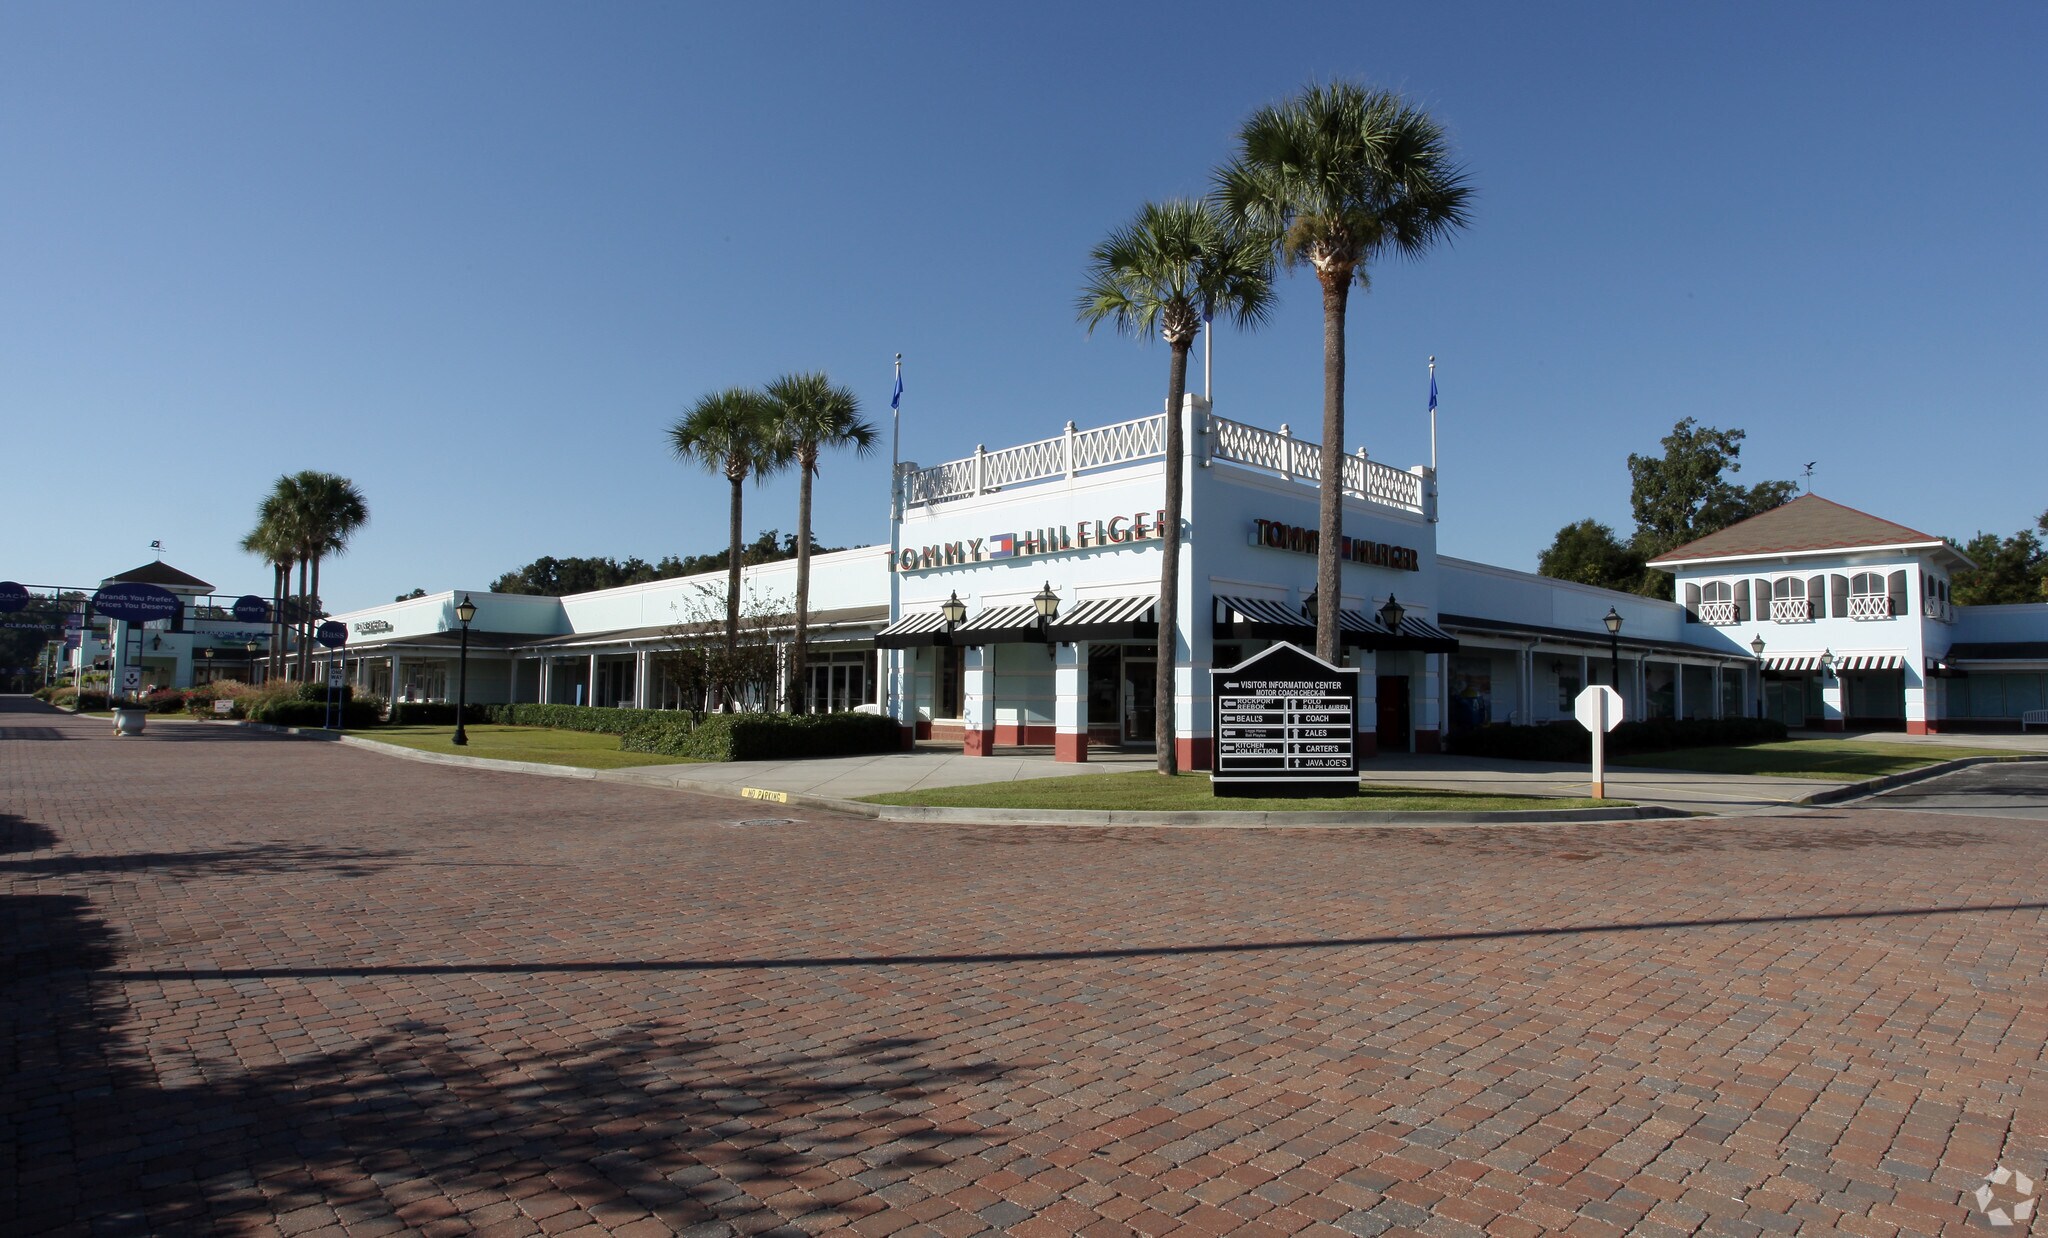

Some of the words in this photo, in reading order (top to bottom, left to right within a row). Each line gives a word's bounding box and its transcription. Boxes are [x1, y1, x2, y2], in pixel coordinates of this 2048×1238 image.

[1254, 518, 1319, 555] TOMM
[884, 538, 983, 572] TOMMY
[99, 593, 127, 601] Brands
[146, 595, 174, 603] Prefer.
[141, 603, 177, 611] Deserve.
[321, 630, 345, 639] Bass
[1240, 681, 1268, 689] VISITOR
[1268, 681, 1314, 689] INFORMATION
[1314, 681, 1342, 689] CENTER
[1277, 689, 1299, 697] COACH
[1236, 715, 1263, 723] BEALL'S
[1305, 715, 1329, 723] COACH
[1305, 729, 1328, 737] ZALES
[1305, 745, 1339, 753] CARTER'S
[1305, 758, 1324, 767] JAVA
[1325, 758, 1348, 767] JOE'S
[748, 789, 756, 797] NO
